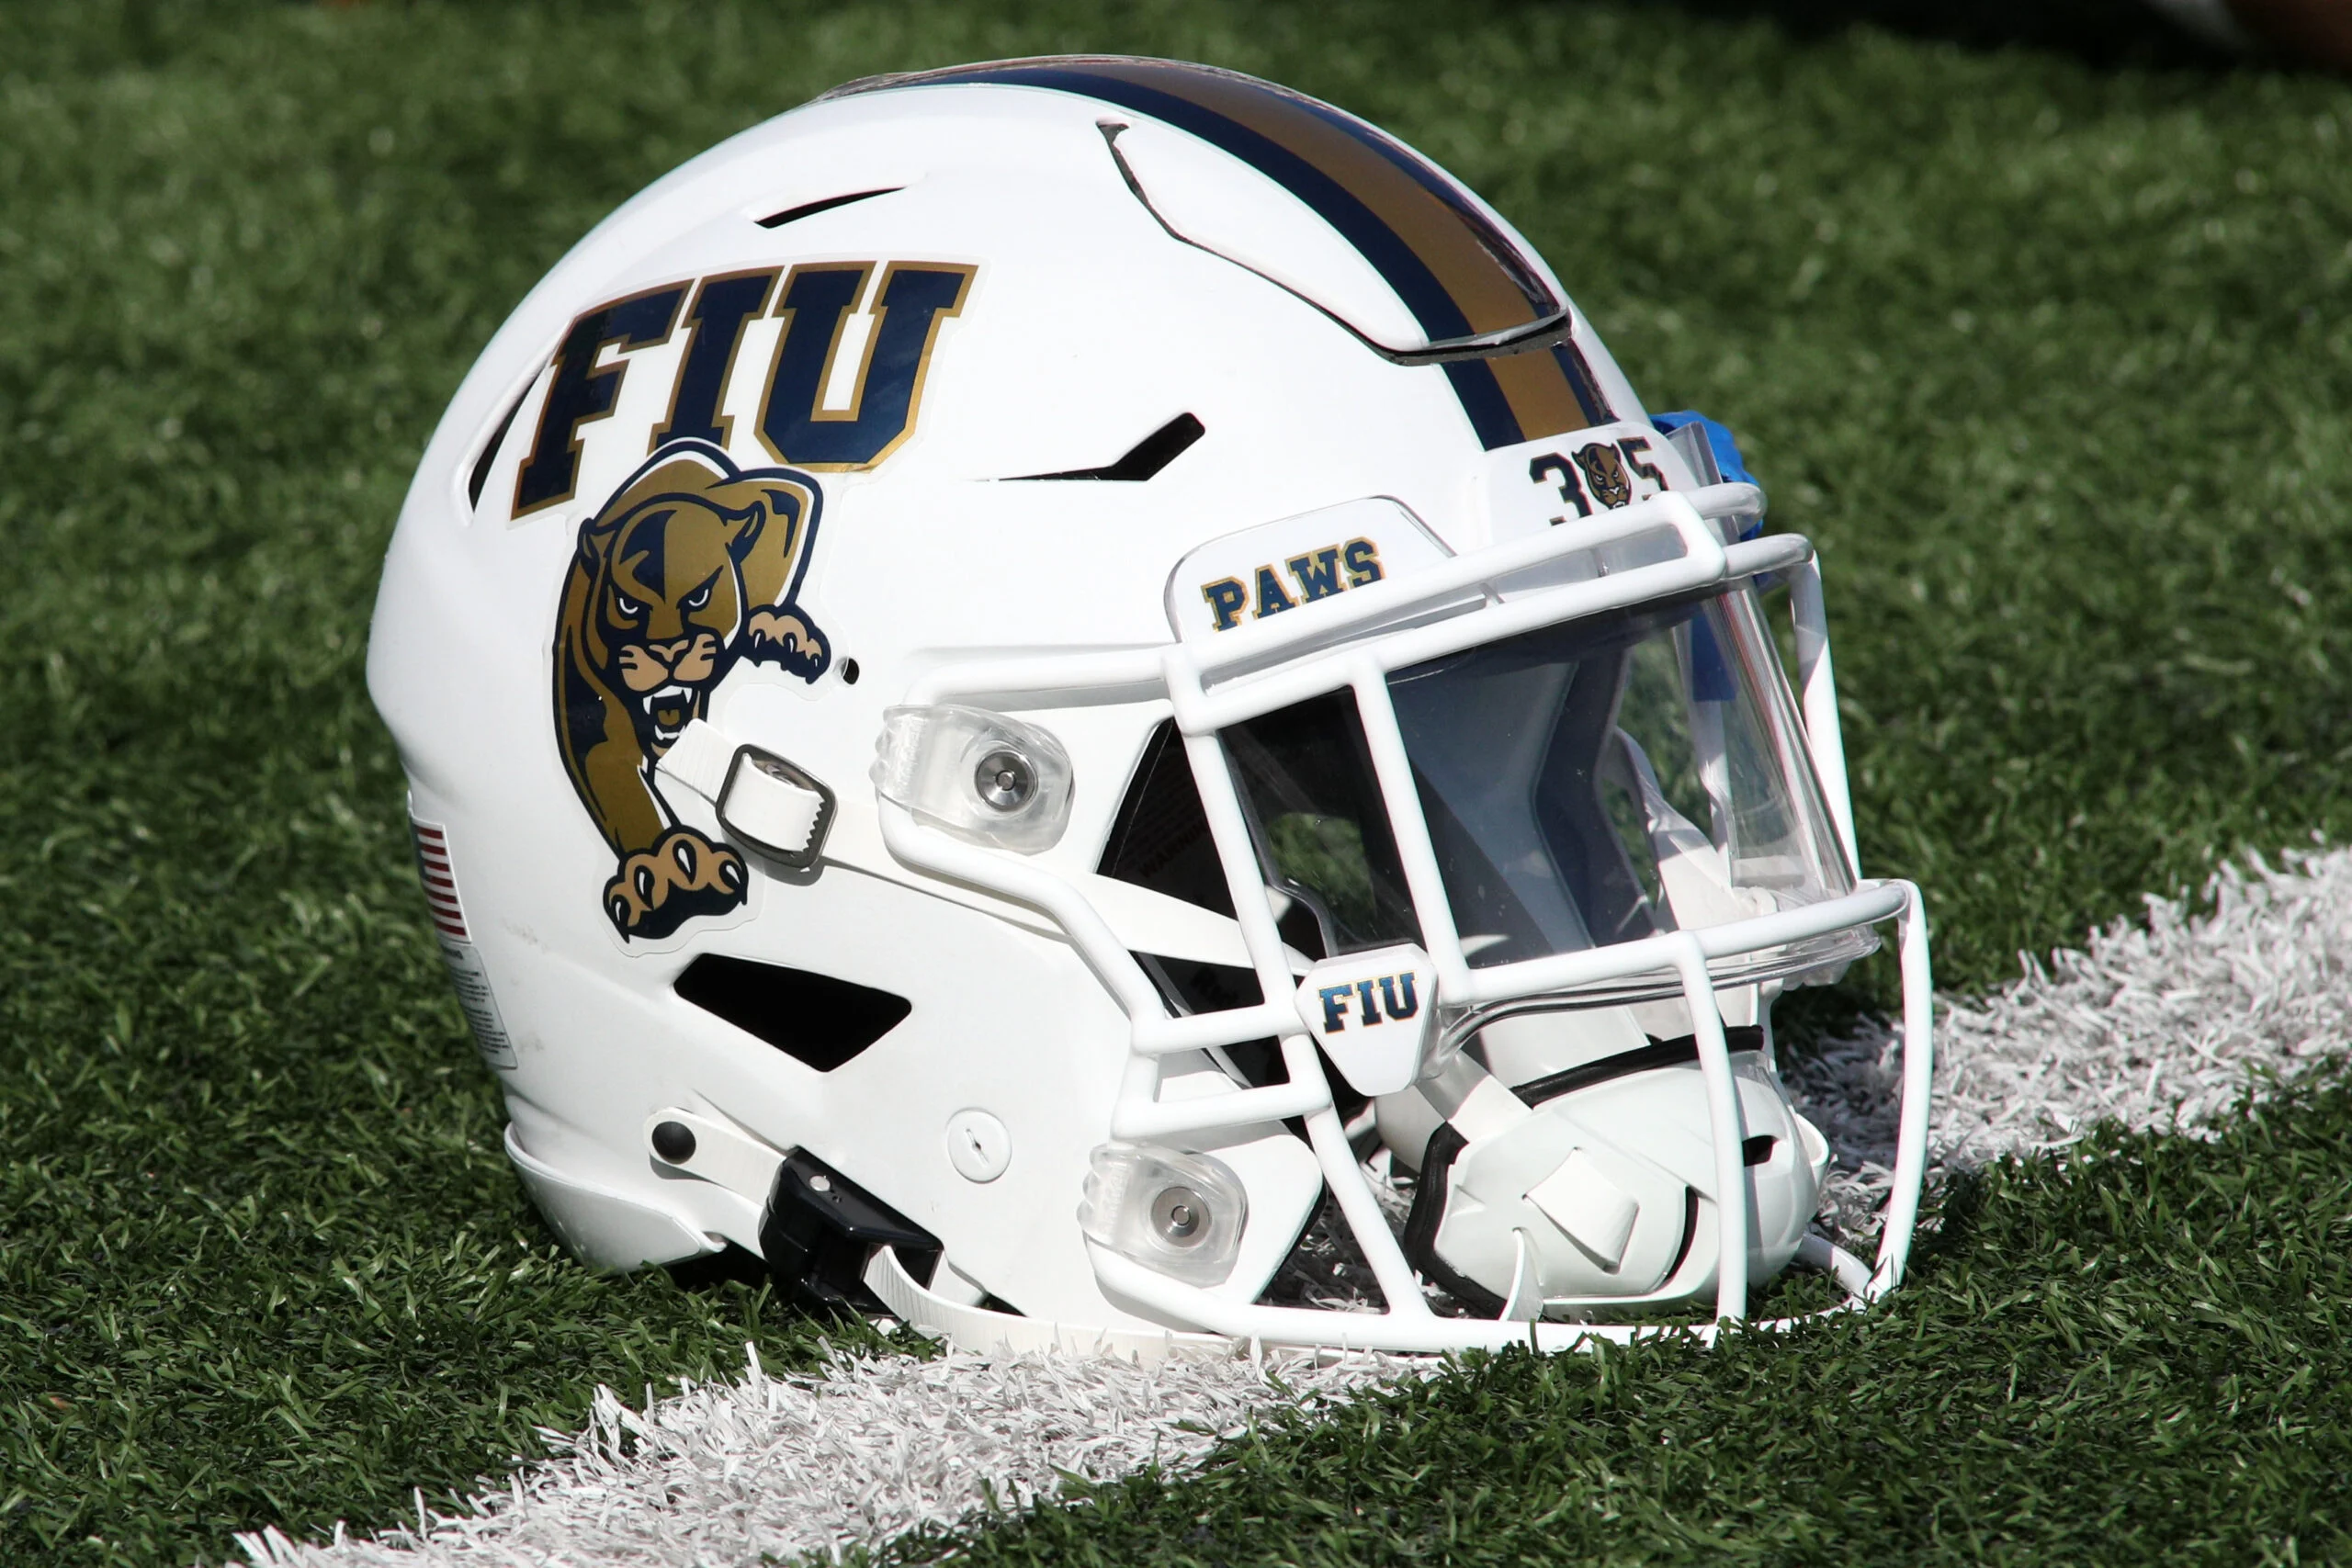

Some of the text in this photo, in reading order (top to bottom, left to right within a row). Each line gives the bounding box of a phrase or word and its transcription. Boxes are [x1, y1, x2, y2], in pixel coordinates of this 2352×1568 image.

[510, 260, 980, 521] FIU
[1200, 536, 1386, 633] PAWS
[1317, 970, 1419, 1034] FIU
